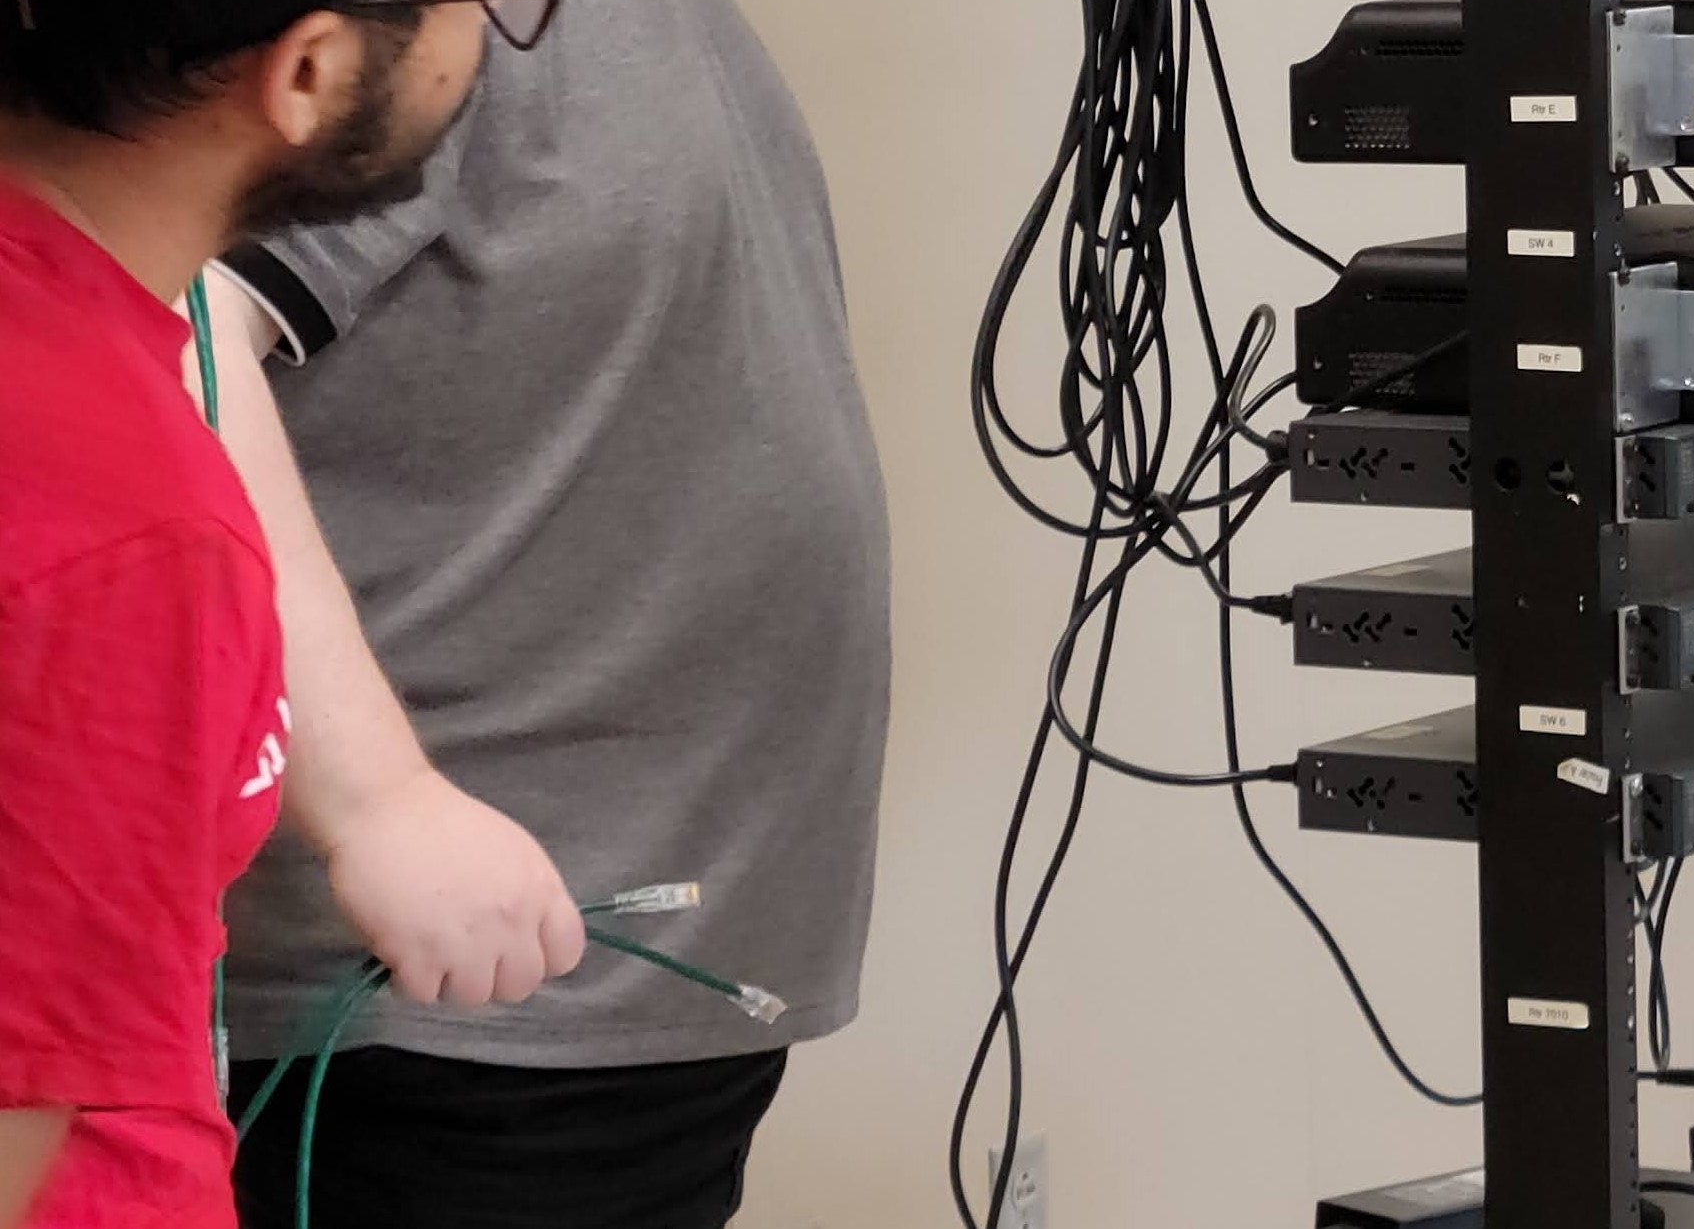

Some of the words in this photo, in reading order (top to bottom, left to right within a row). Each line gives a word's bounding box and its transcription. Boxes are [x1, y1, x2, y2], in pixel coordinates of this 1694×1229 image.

[1531, 104, 1546, 115] Rtr
[1548, 103, 1556, 114] E
[1528, 238, 1546, 249] SW
[1547, 238, 1555, 248] 4
[1538, 353, 1552, 363] Rtr
[1553, 353, 1561, 364] F
[1539, 714, 1557, 726] SW
